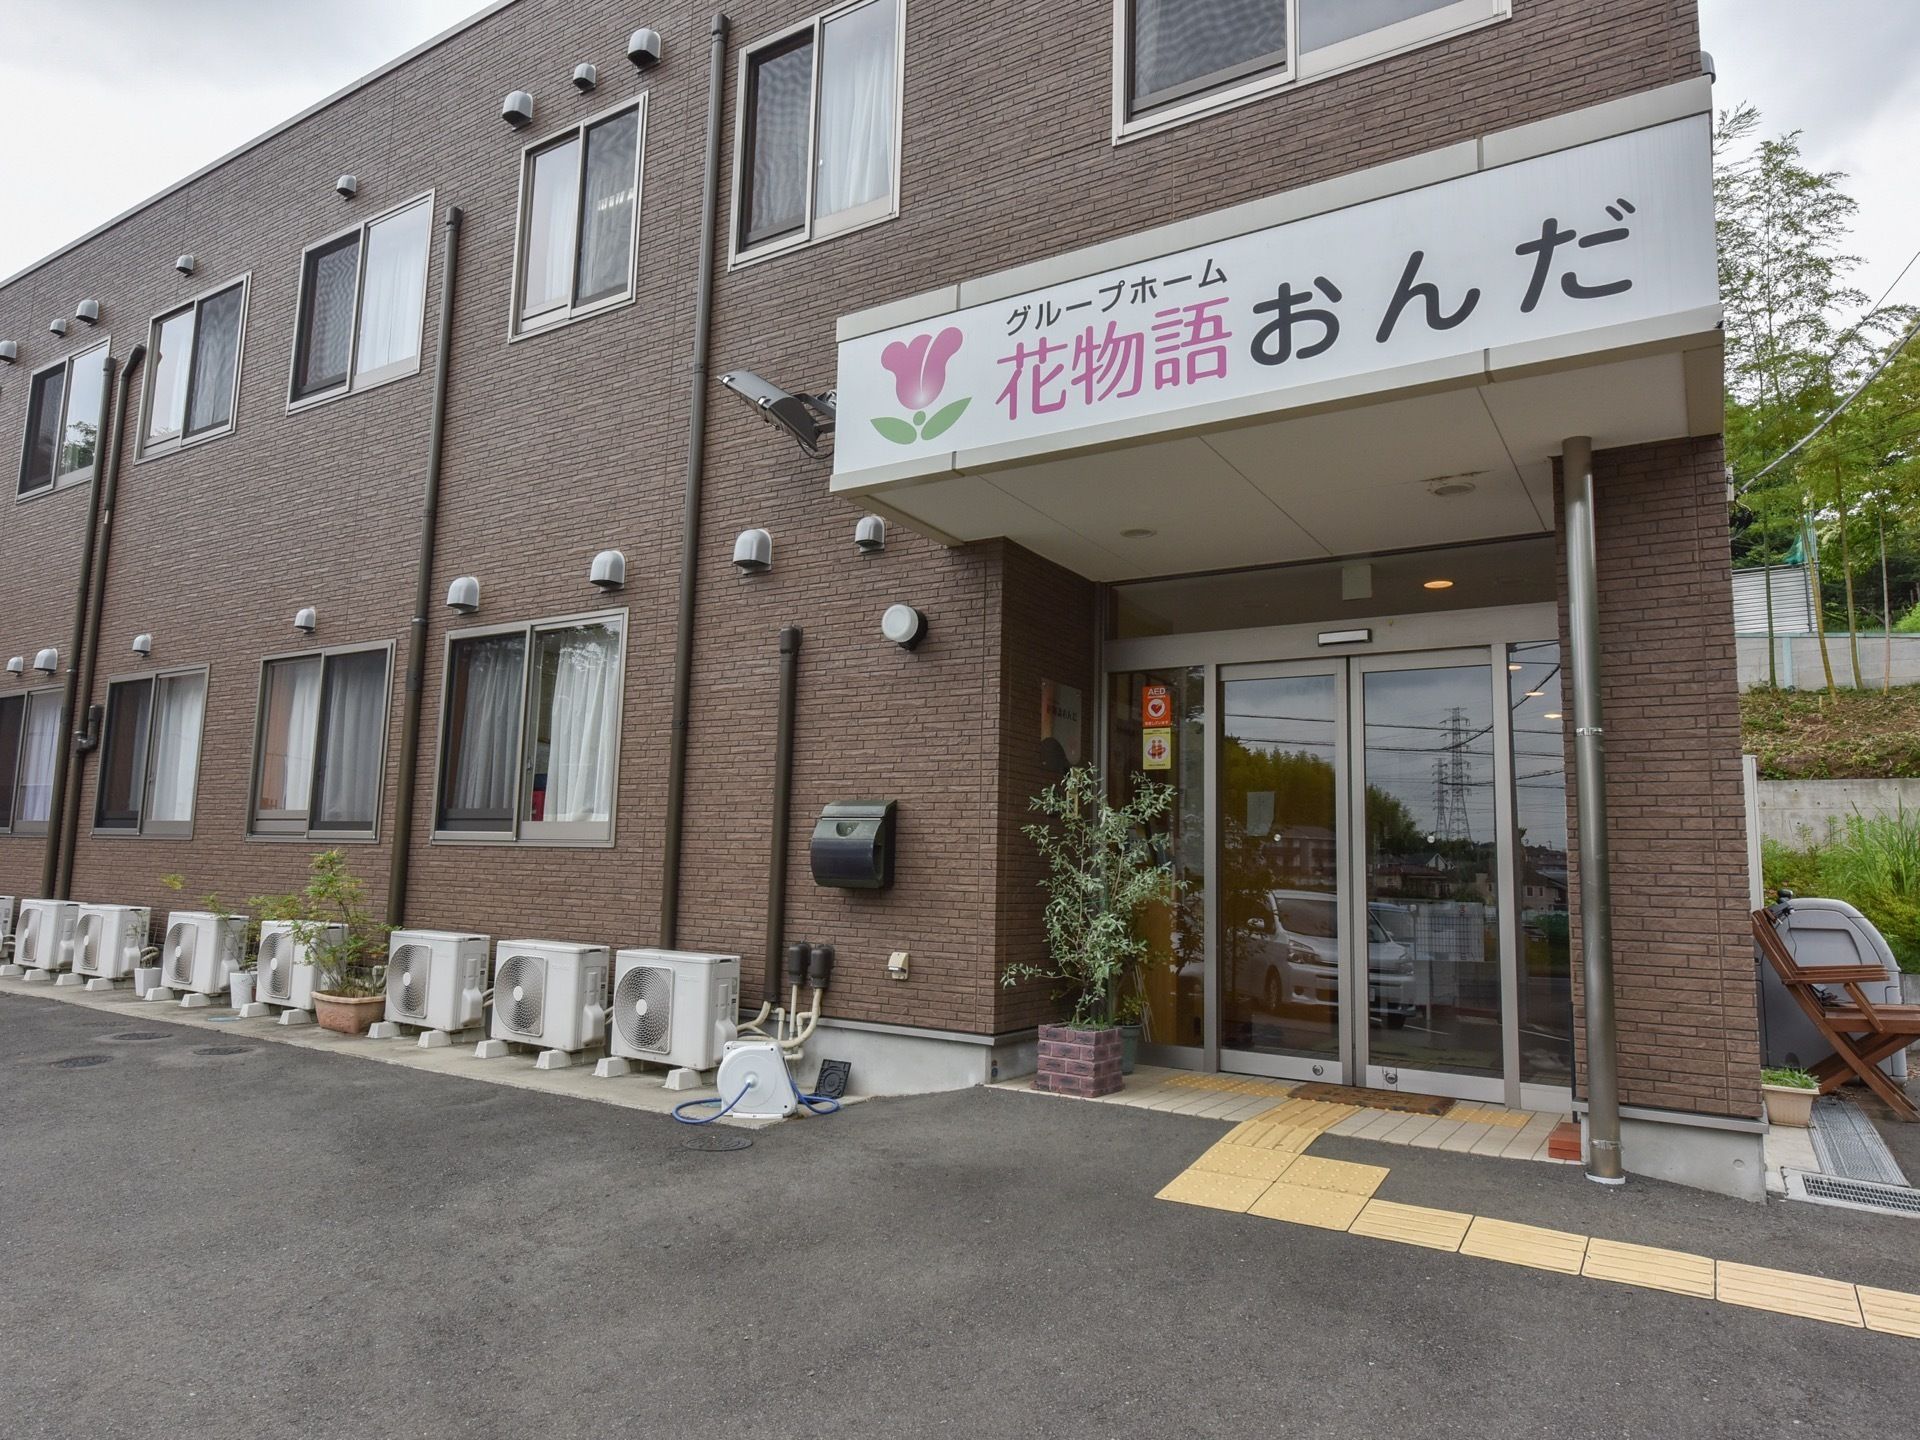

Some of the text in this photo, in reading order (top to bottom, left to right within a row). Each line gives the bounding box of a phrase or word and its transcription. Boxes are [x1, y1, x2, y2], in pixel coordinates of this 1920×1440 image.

[995, 198, 1637, 421] 花物語 おんだ
[1006, 258, 1228, 337] グループホーム
[1147, 687, 1166, 696] AED
